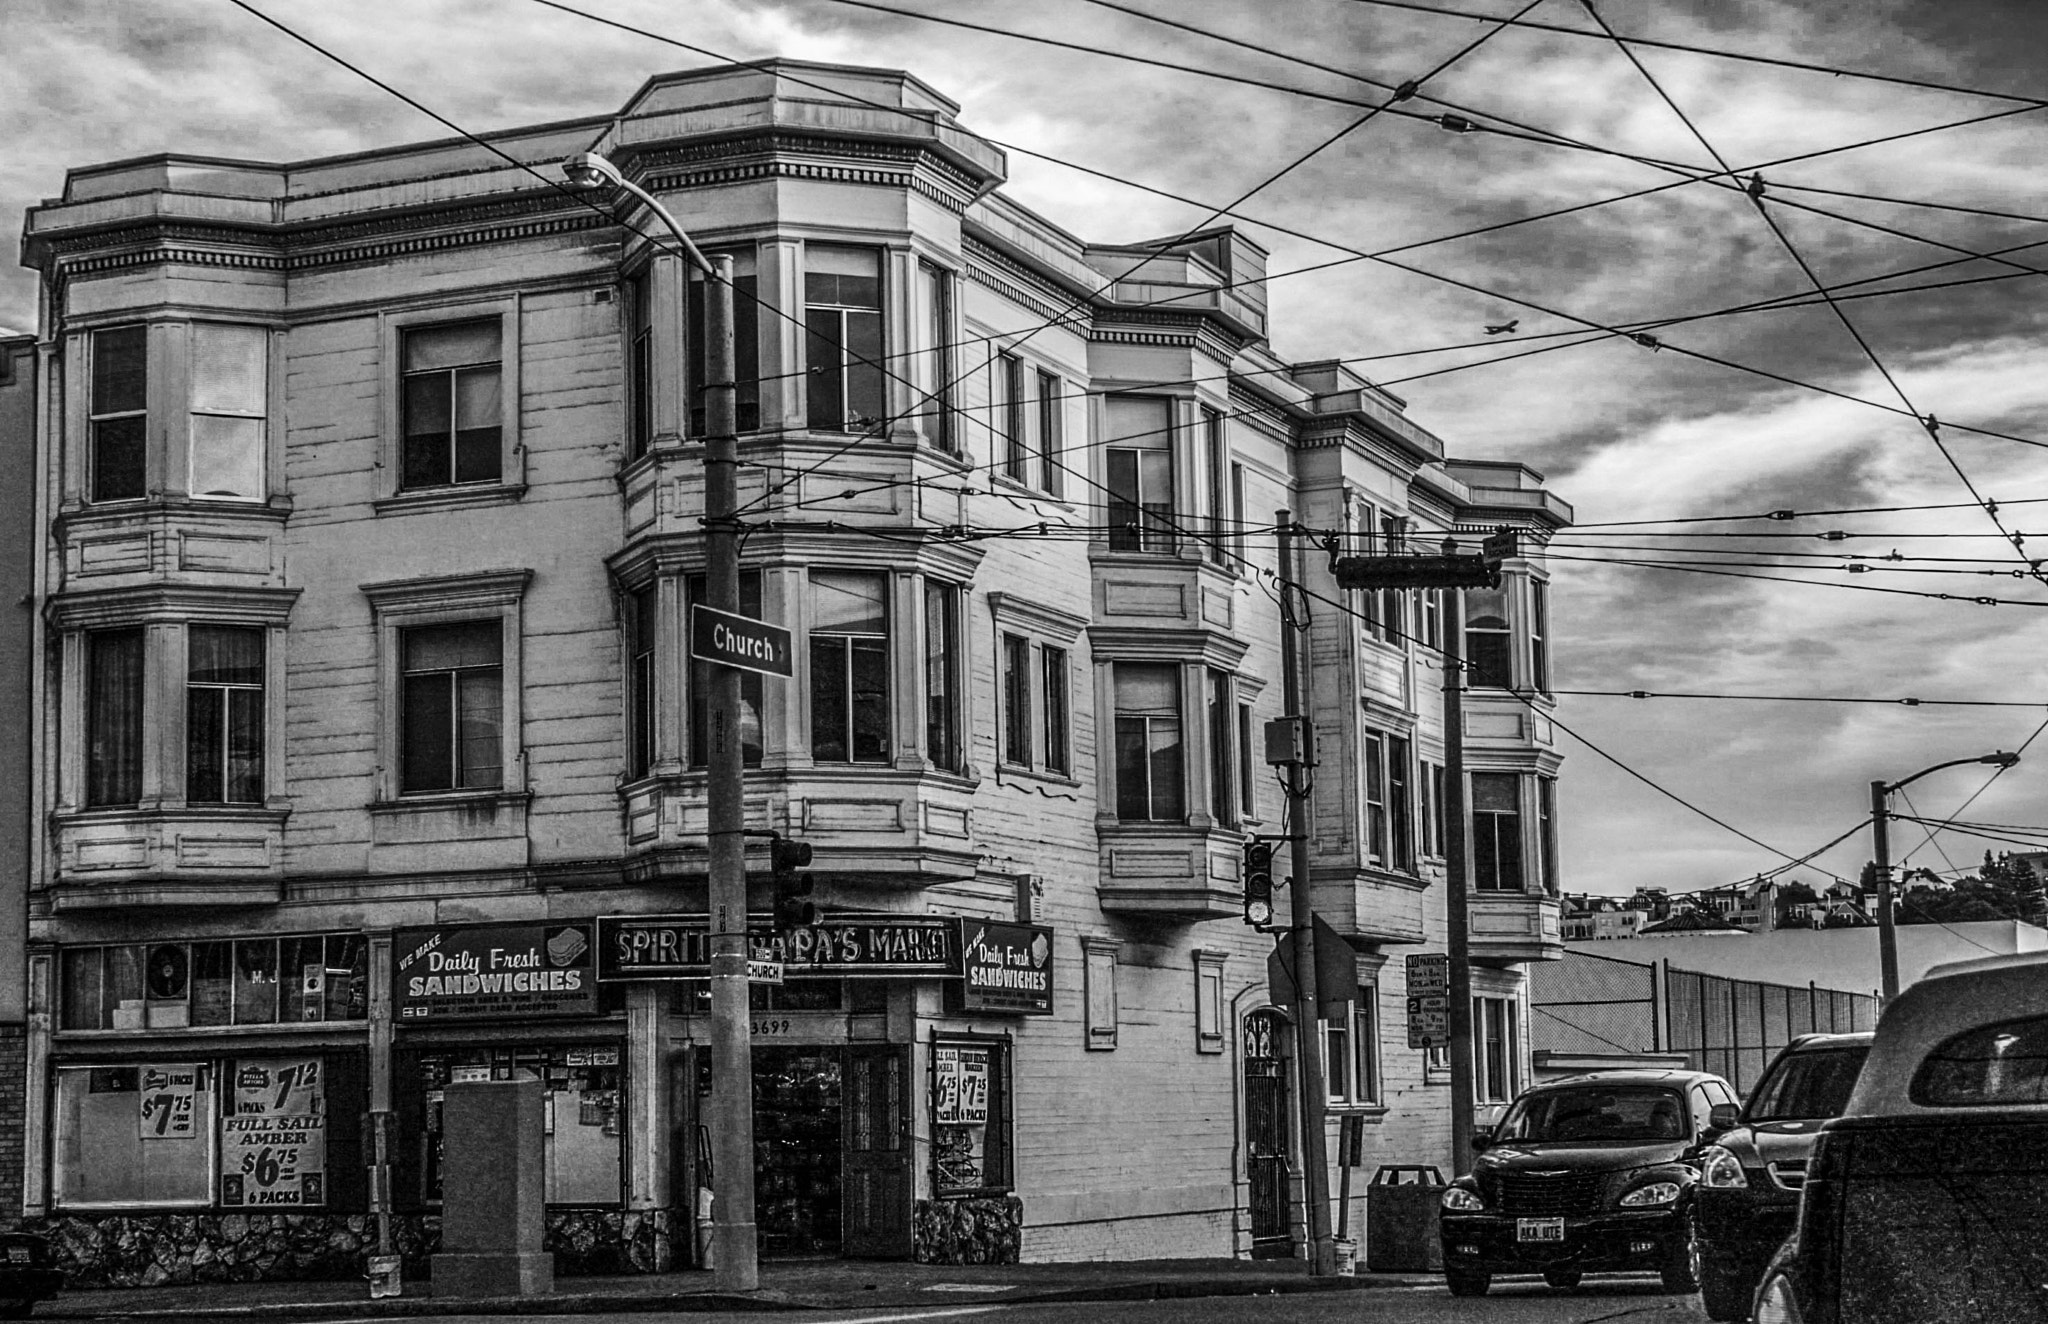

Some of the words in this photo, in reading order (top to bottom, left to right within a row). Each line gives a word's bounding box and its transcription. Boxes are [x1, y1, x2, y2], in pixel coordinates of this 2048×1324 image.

[714, 623, 773, 662] Church
[399, 953, 414, 972] WE
[415, 933, 442, 960] MAKE
[615, 928, 711, 963] SPIRIT
[428, 950, 481, 975] Daily
[490, 948, 541, 969] Fresh
[979, 943, 1003, 969] Daily
[1007, 945, 1030, 966] Fresh
[1407, 956, 1418, 967] NO
[1420, 957, 1446, 966] PARKING
[747, 963, 779, 979] CHURCH
[971, 965, 1046, 991] SANDWICHES
[409, 970, 581, 997] SANDWICHES
[1409, 1001, 1418, 1012] 2
[750, 1020, 789, 1035] 3699
[966, 1109, 986, 1121] PACKS
[226, 1119, 272, 1132] FULL
[278, 1117, 322, 1130] SAIL
[239, 1132, 307, 1145] AMBER
[249, 1192, 256, 1204] 6
[259, 1191, 299, 1204] PACKS
